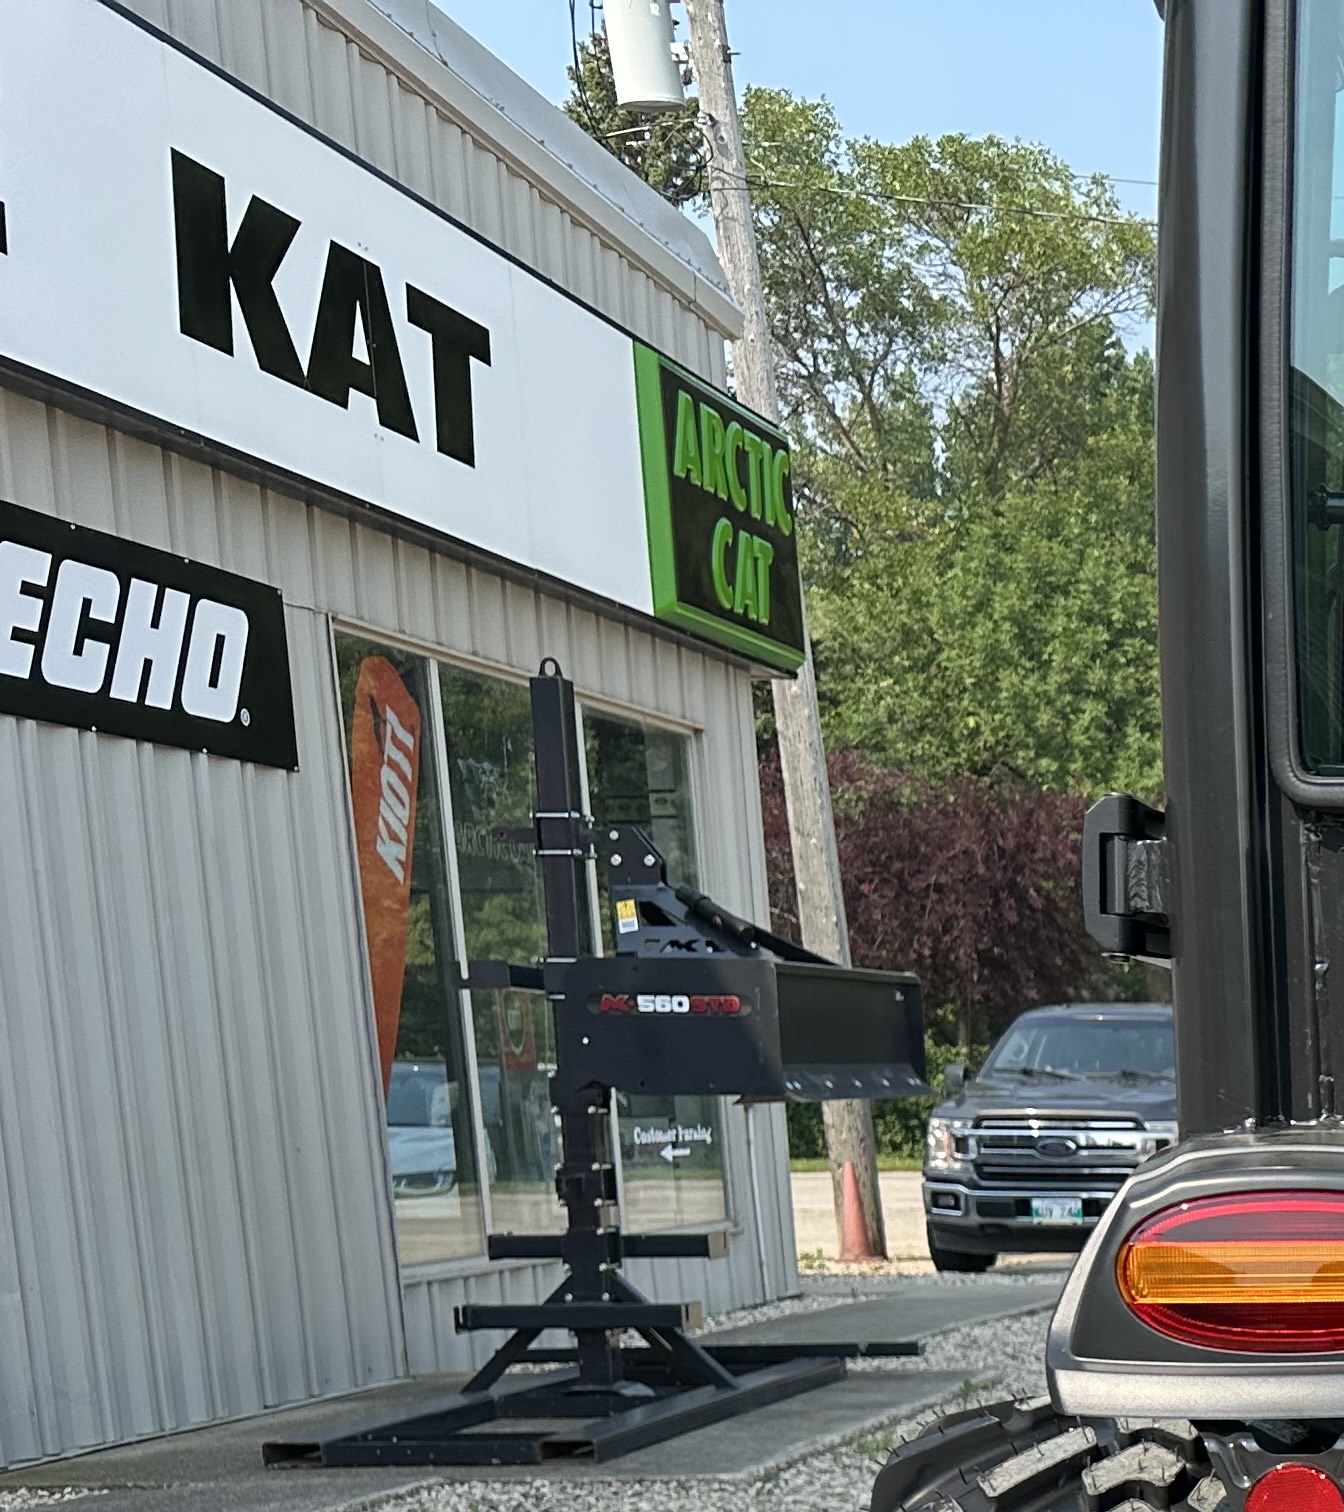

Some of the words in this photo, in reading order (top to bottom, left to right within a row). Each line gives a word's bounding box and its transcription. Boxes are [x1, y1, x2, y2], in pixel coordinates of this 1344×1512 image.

[171, 146, 491, 469] KAT
[674, 389, 793, 536] ARCTIC
[0, 540, 249, 723] ECHO
[711, 517, 774, 626] CAT
[376, 704, 414, 886] KIOTI
